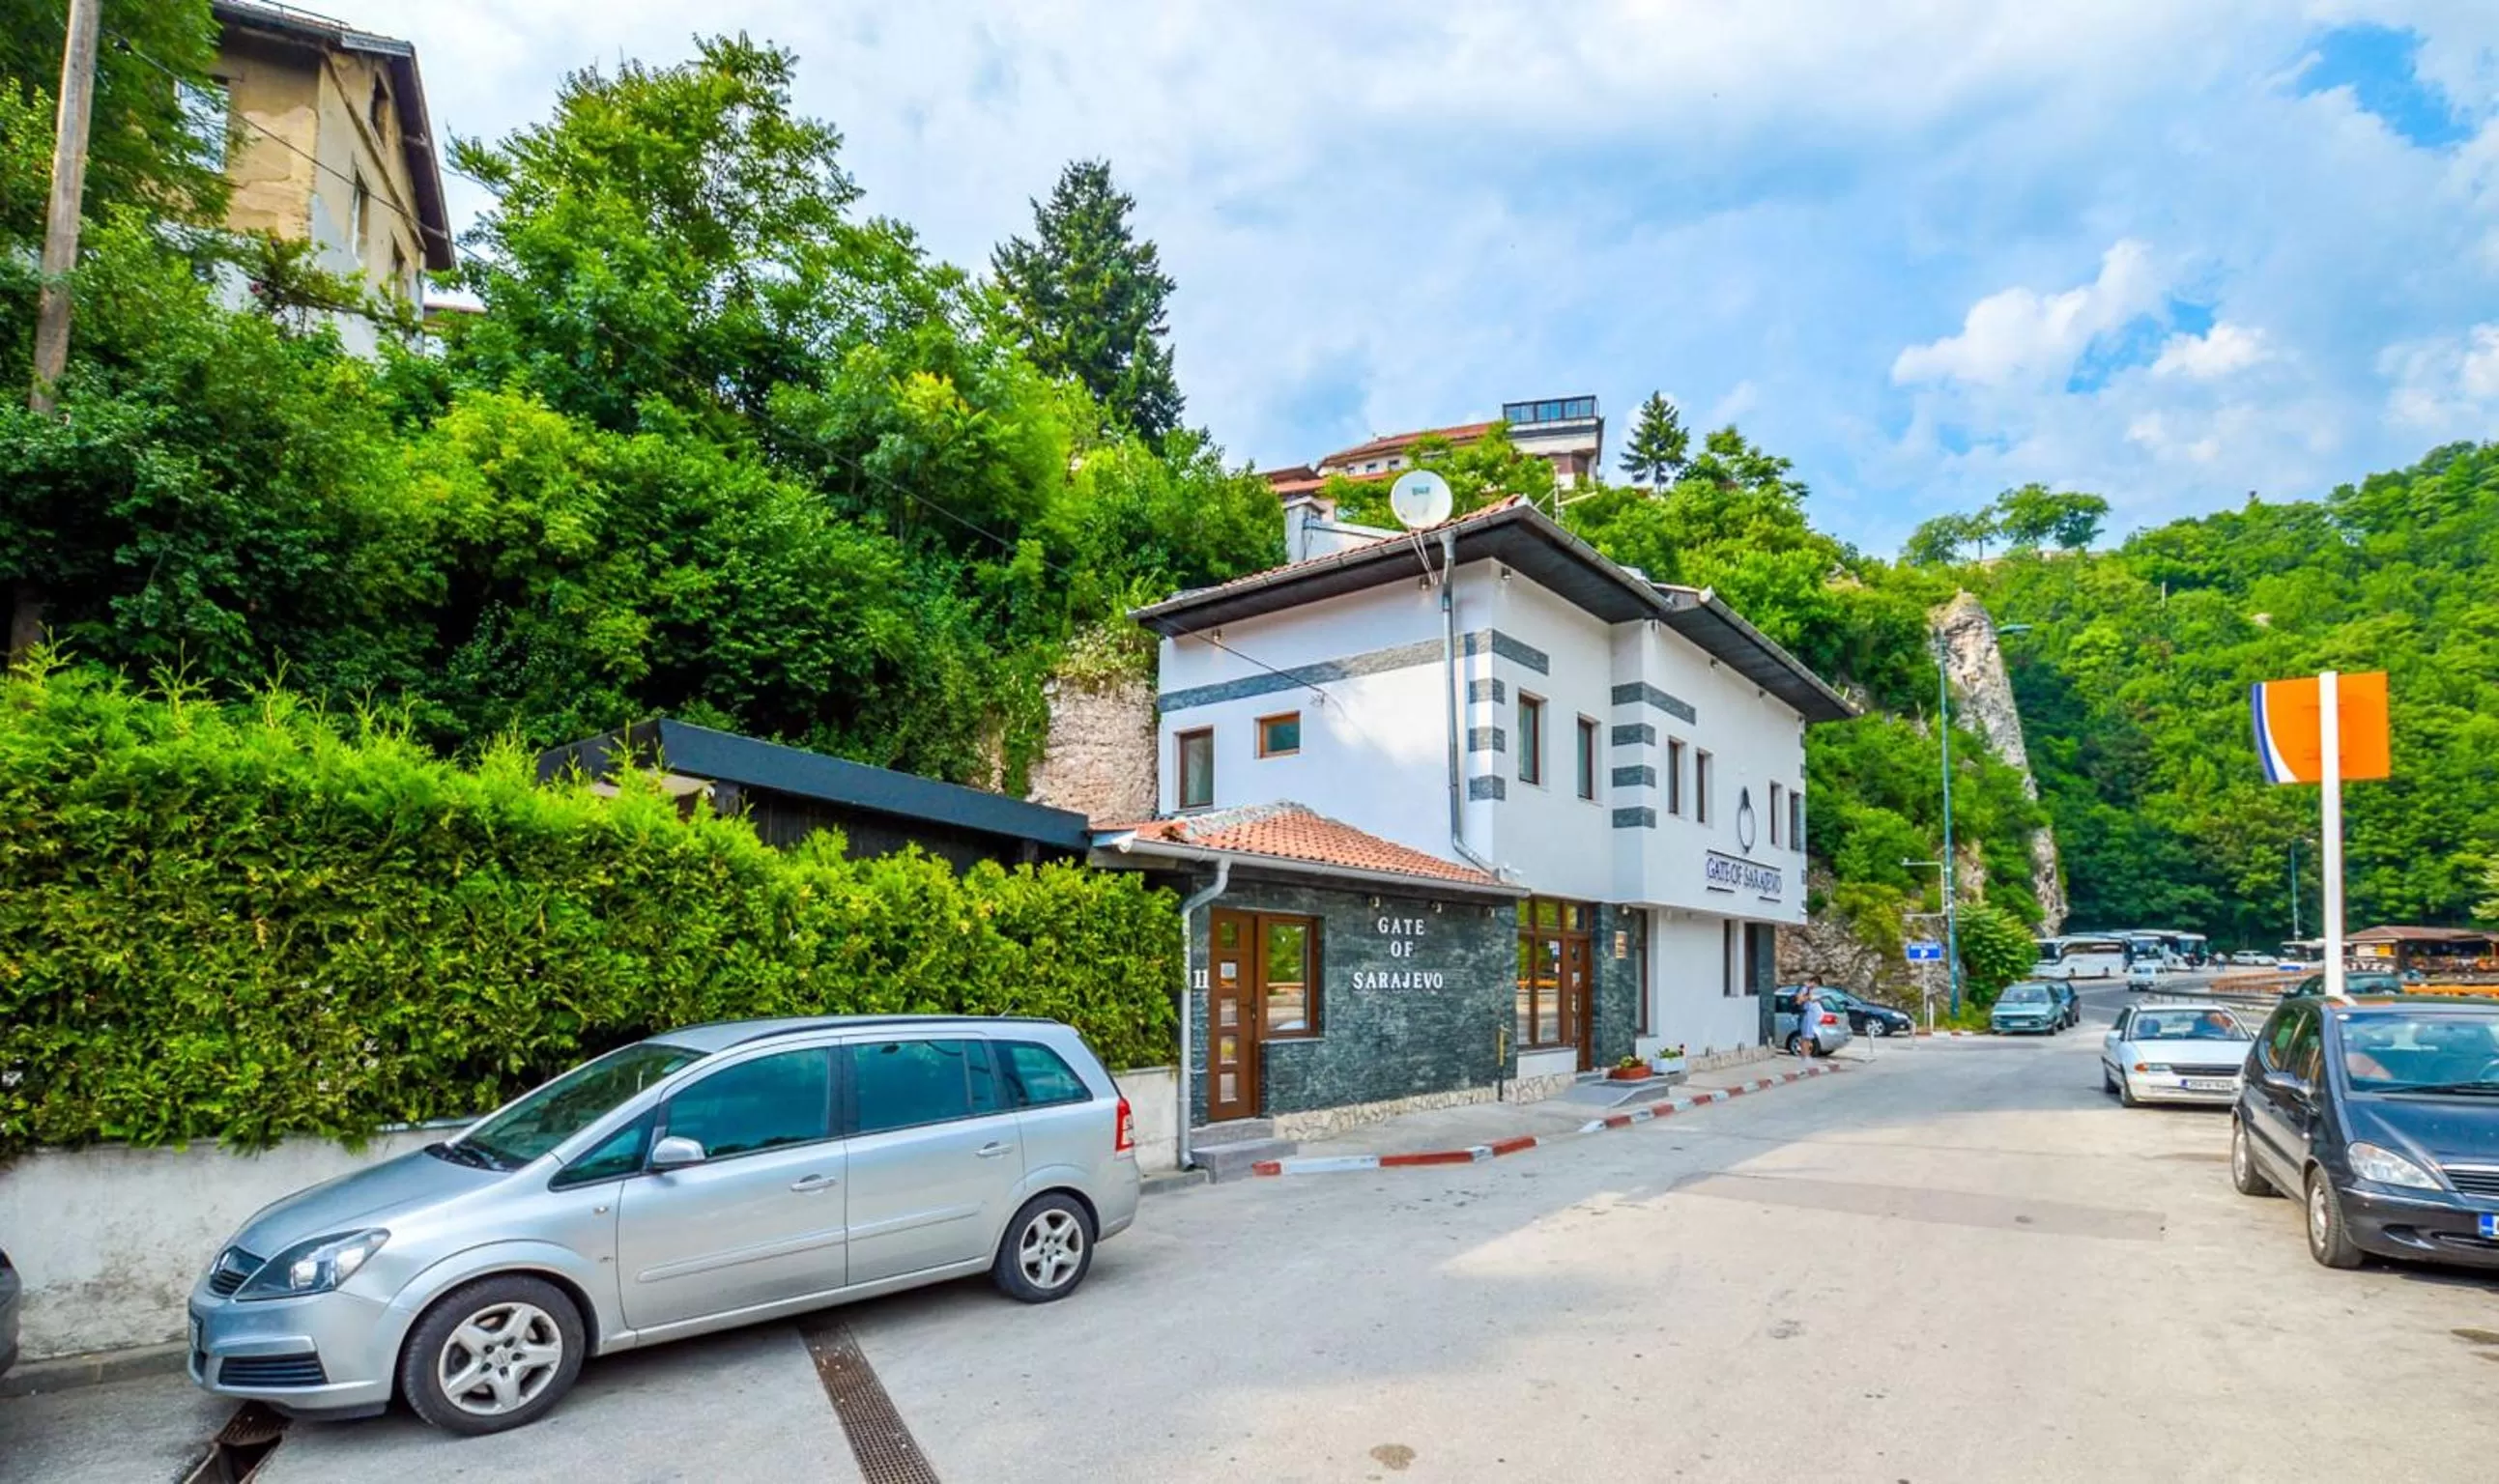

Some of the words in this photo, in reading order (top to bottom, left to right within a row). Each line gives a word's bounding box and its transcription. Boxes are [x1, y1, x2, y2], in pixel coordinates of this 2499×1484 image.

[1707, 857, 1730, 882] GATE
[1377, 916, 1425, 935] GATE
[1390, 940, 1414, 957] OF
[1353, 971, 1443, 989] SARAJEVO
